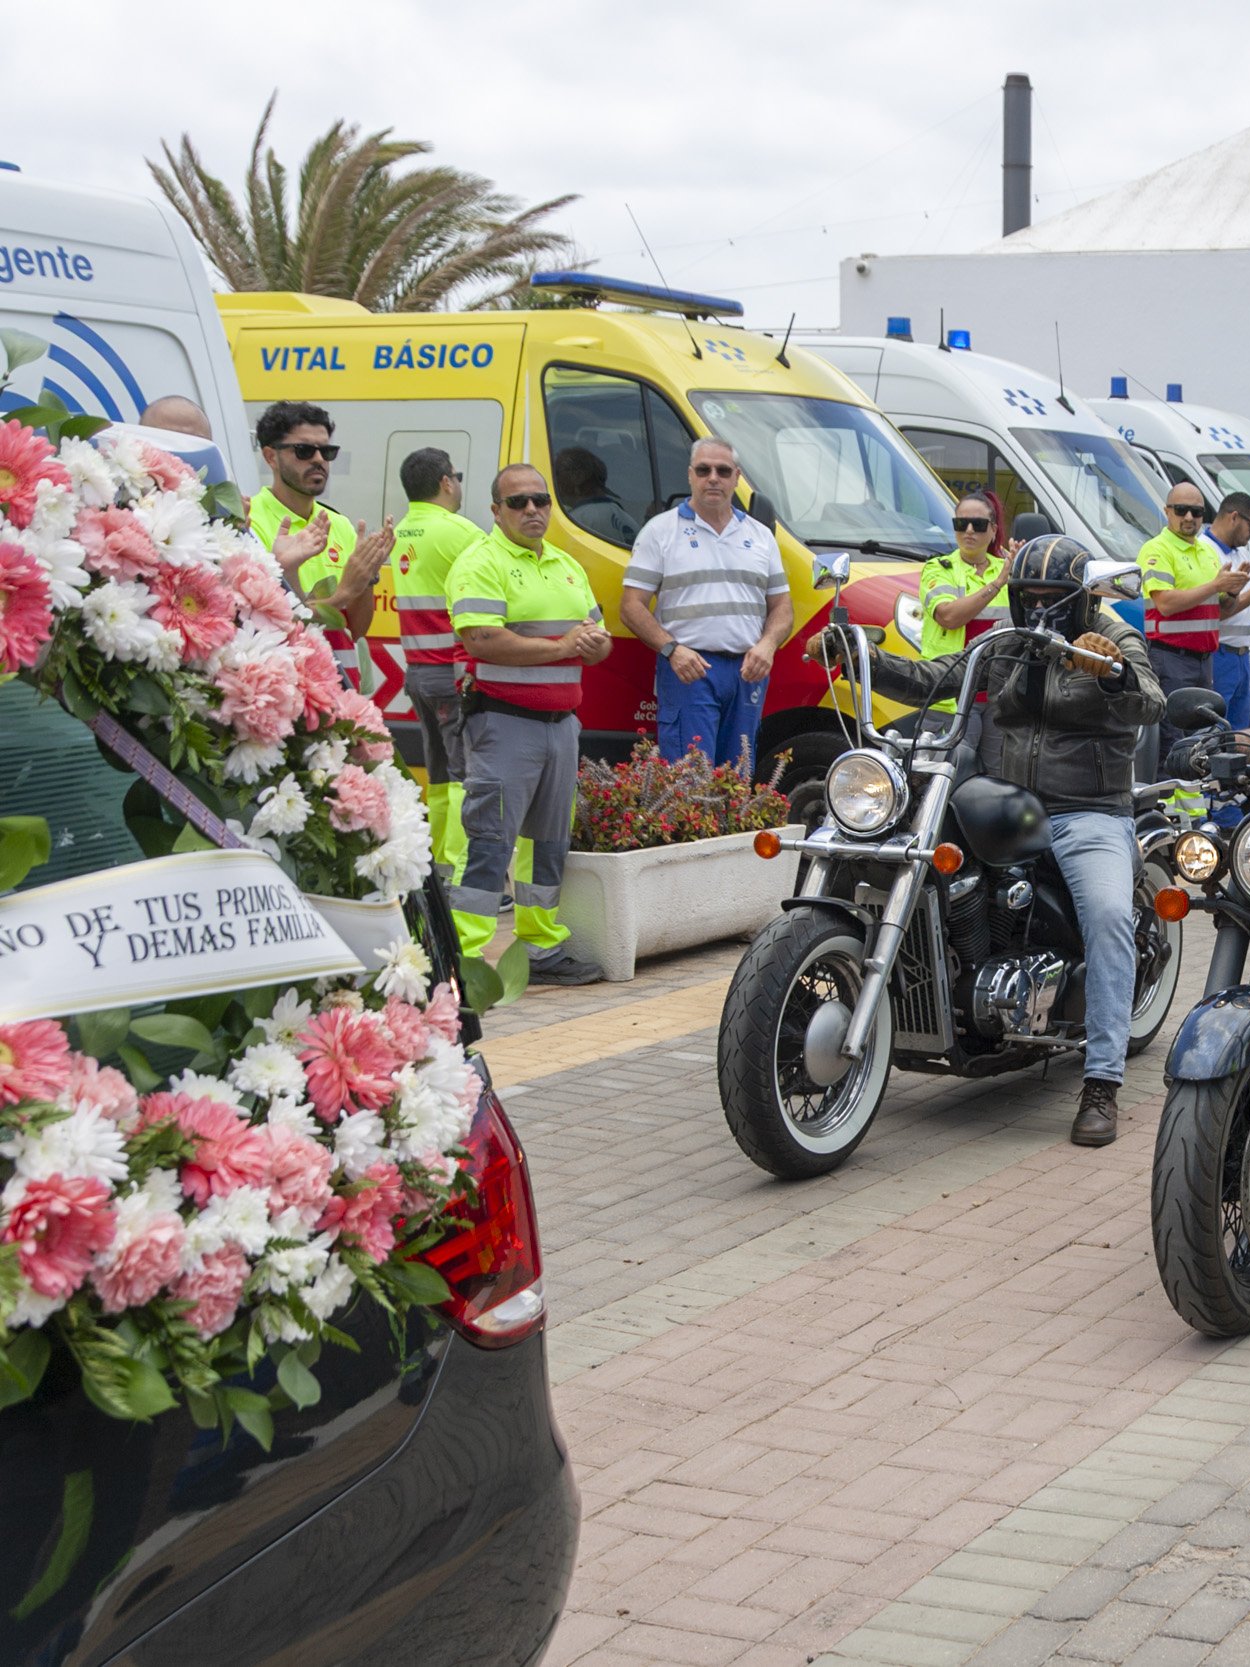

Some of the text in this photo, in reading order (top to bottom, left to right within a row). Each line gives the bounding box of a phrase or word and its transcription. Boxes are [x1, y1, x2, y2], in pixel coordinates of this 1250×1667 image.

[261, 338, 494, 371] VITAL BÁSICO
[633, 710, 645, 720] de
[65, 904, 122, 939] DE
[135, 891, 202, 926] TUS
[216, 884, 298, 917] PRIMOS,
[78, 912, 326, 969] Y DEMAS FAMILIA
